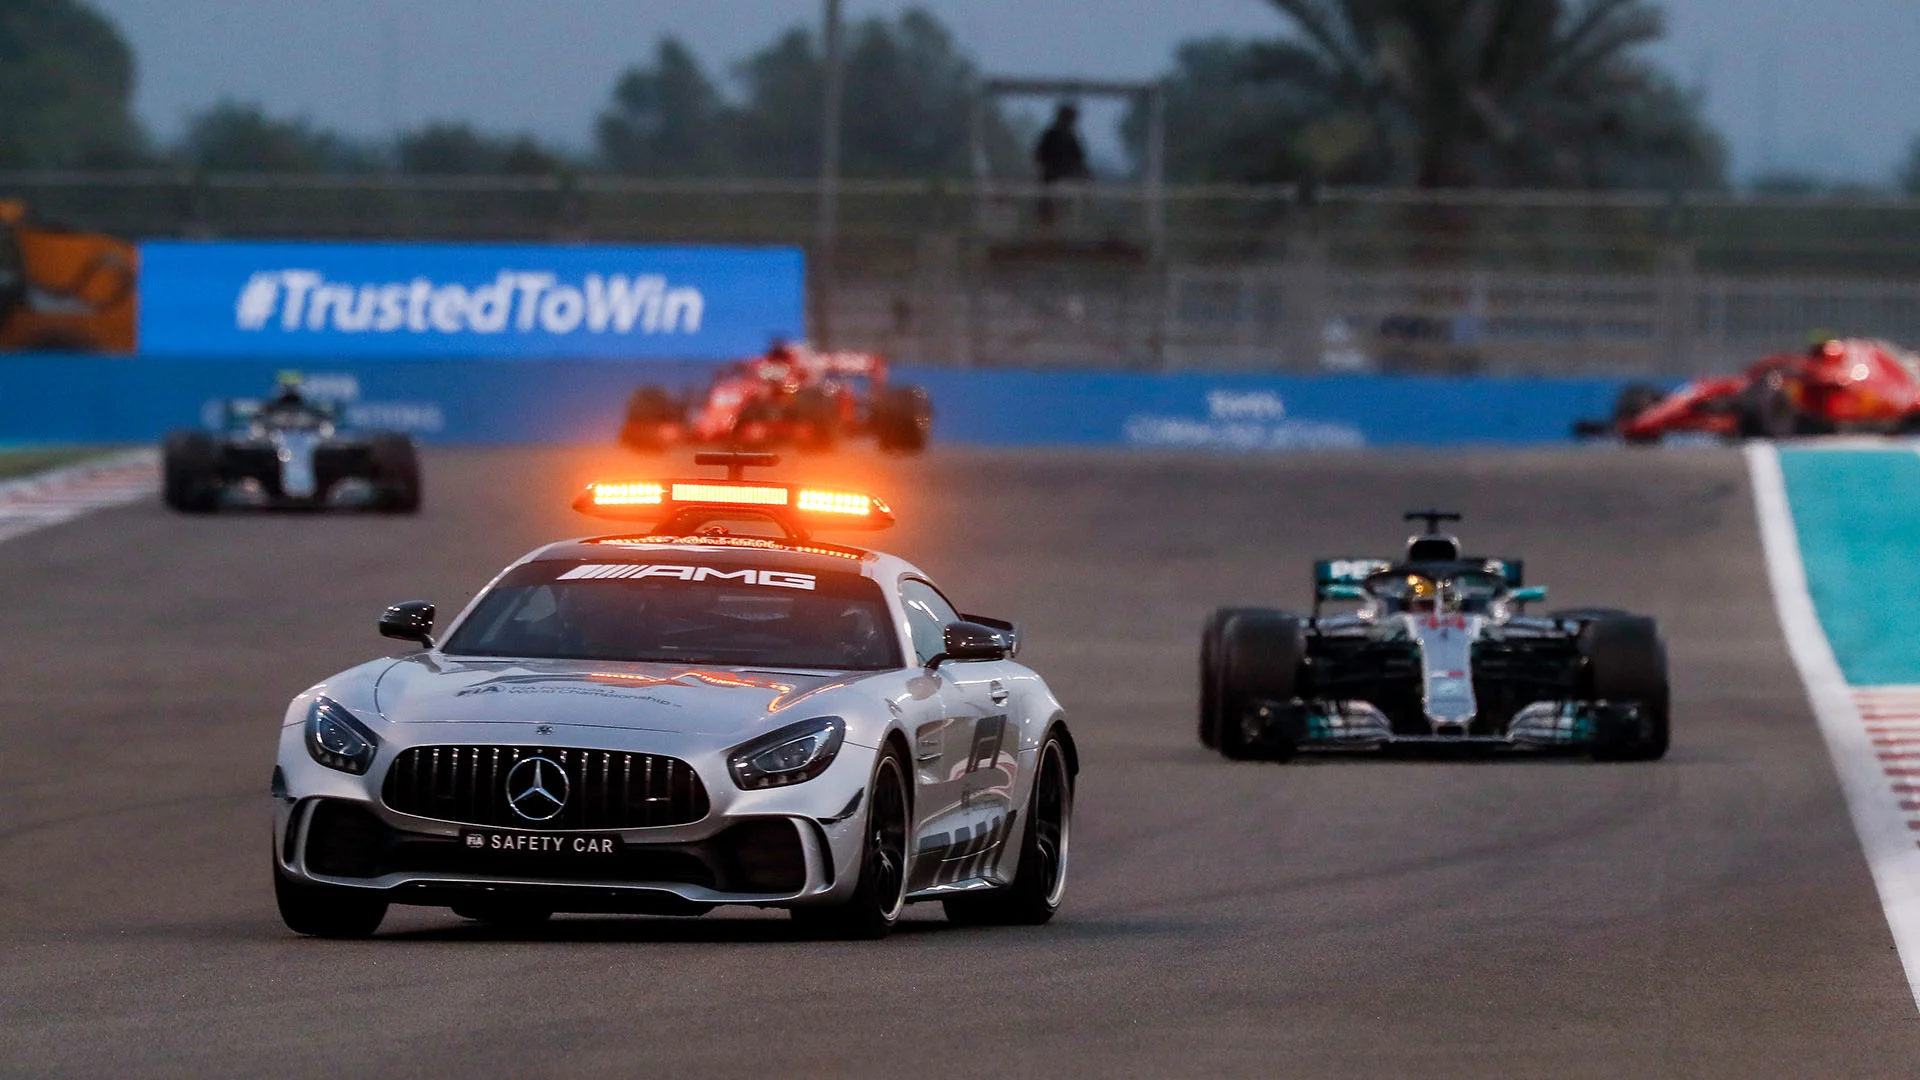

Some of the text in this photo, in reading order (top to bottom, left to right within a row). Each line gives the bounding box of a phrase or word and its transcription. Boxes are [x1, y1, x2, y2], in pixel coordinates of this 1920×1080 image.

[236, 268, 703, 334] #TrustedToWin
[632, 564, 817, 590] AMG
[558, 689, 672, 706] Championship
[466, 834, 613, 853] FIA SAFETY CAR
